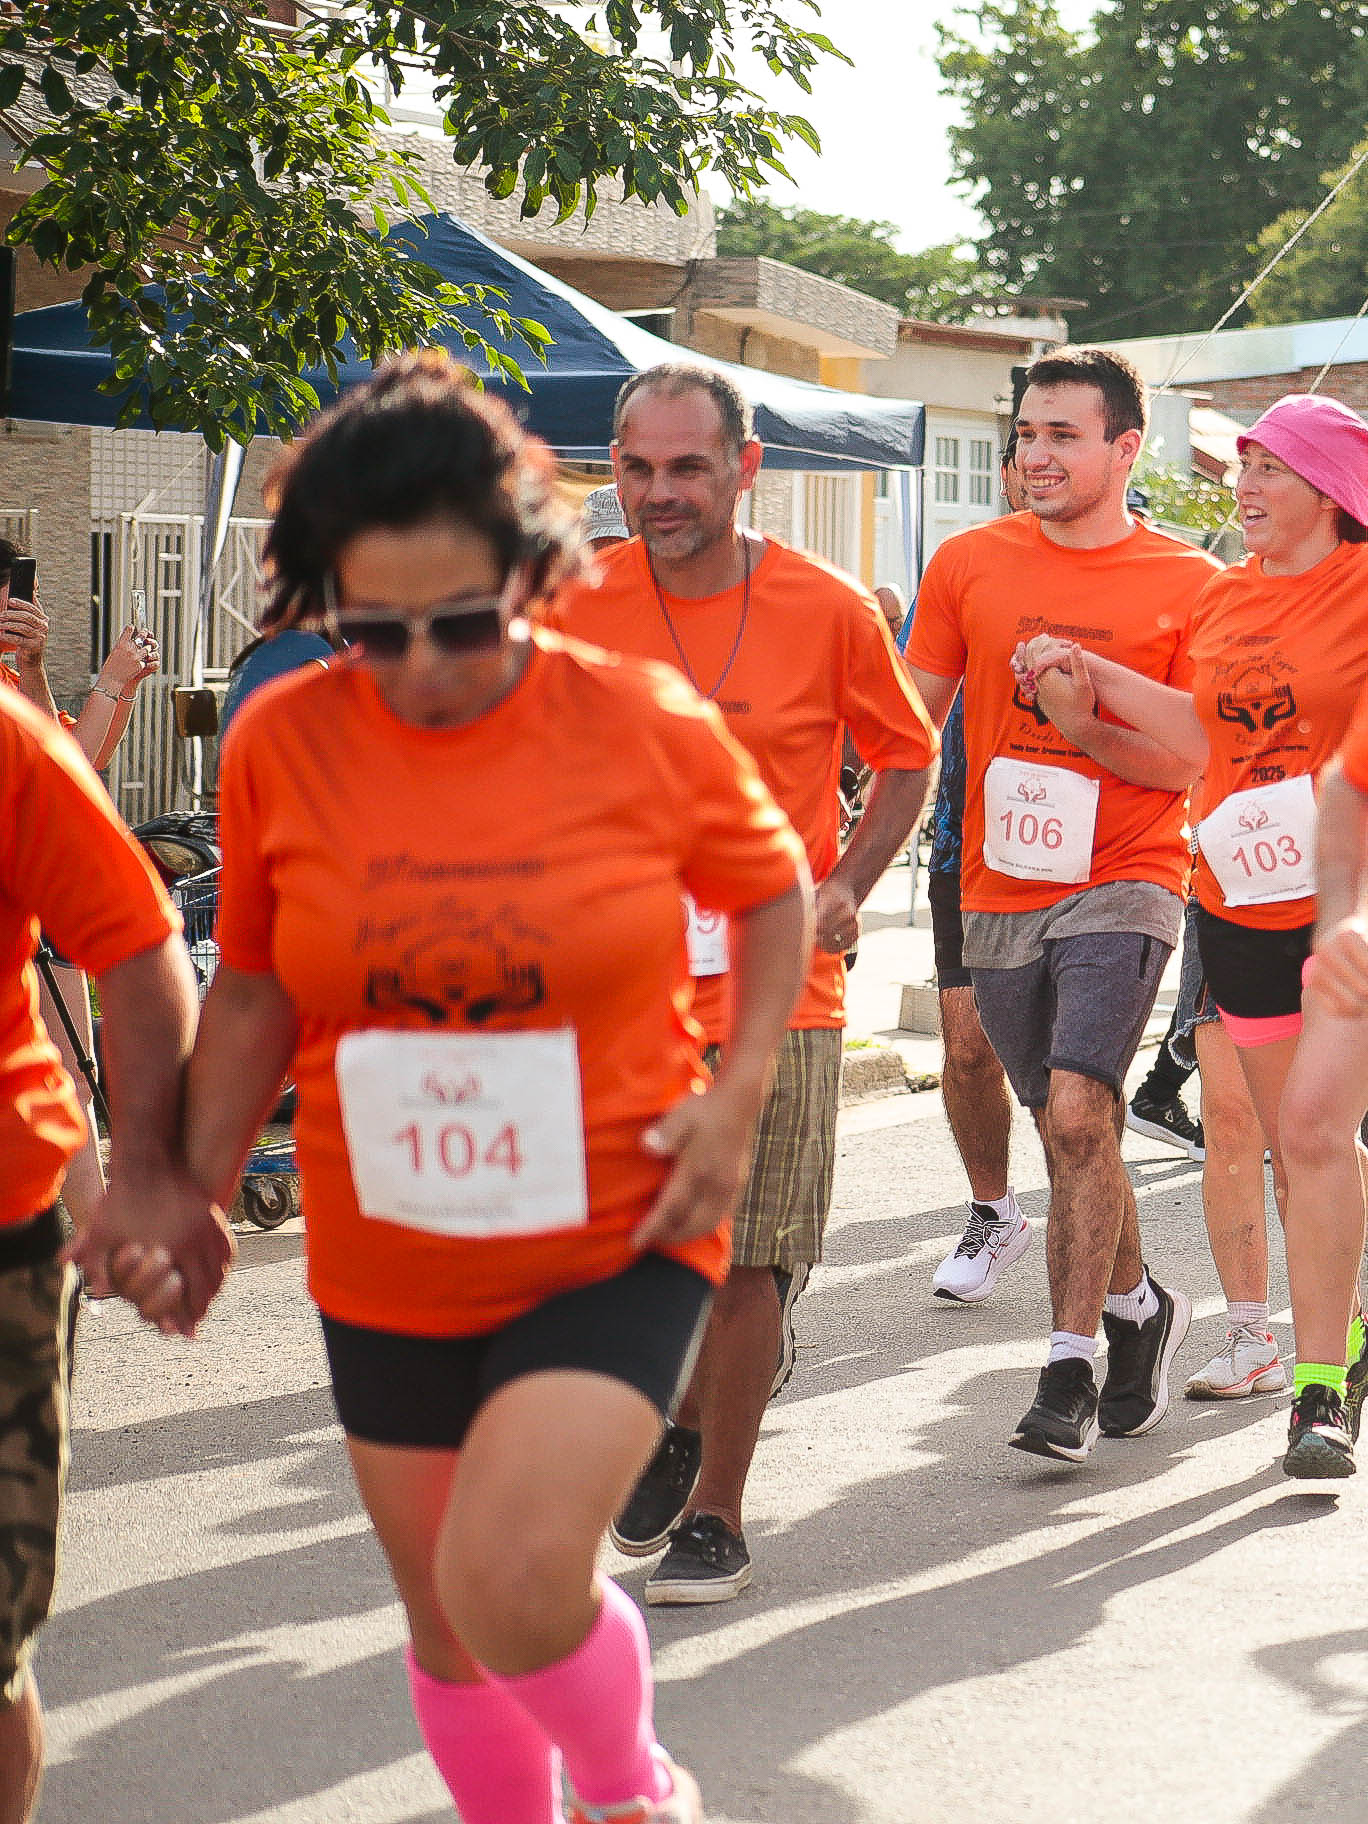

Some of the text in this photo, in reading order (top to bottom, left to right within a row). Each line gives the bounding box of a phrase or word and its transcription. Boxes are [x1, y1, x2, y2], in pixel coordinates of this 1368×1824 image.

[1000, 809, 1063, 849] 106
[1232, 835, 1302, 877] 103
[391, 1120, 527, 1178] 104
